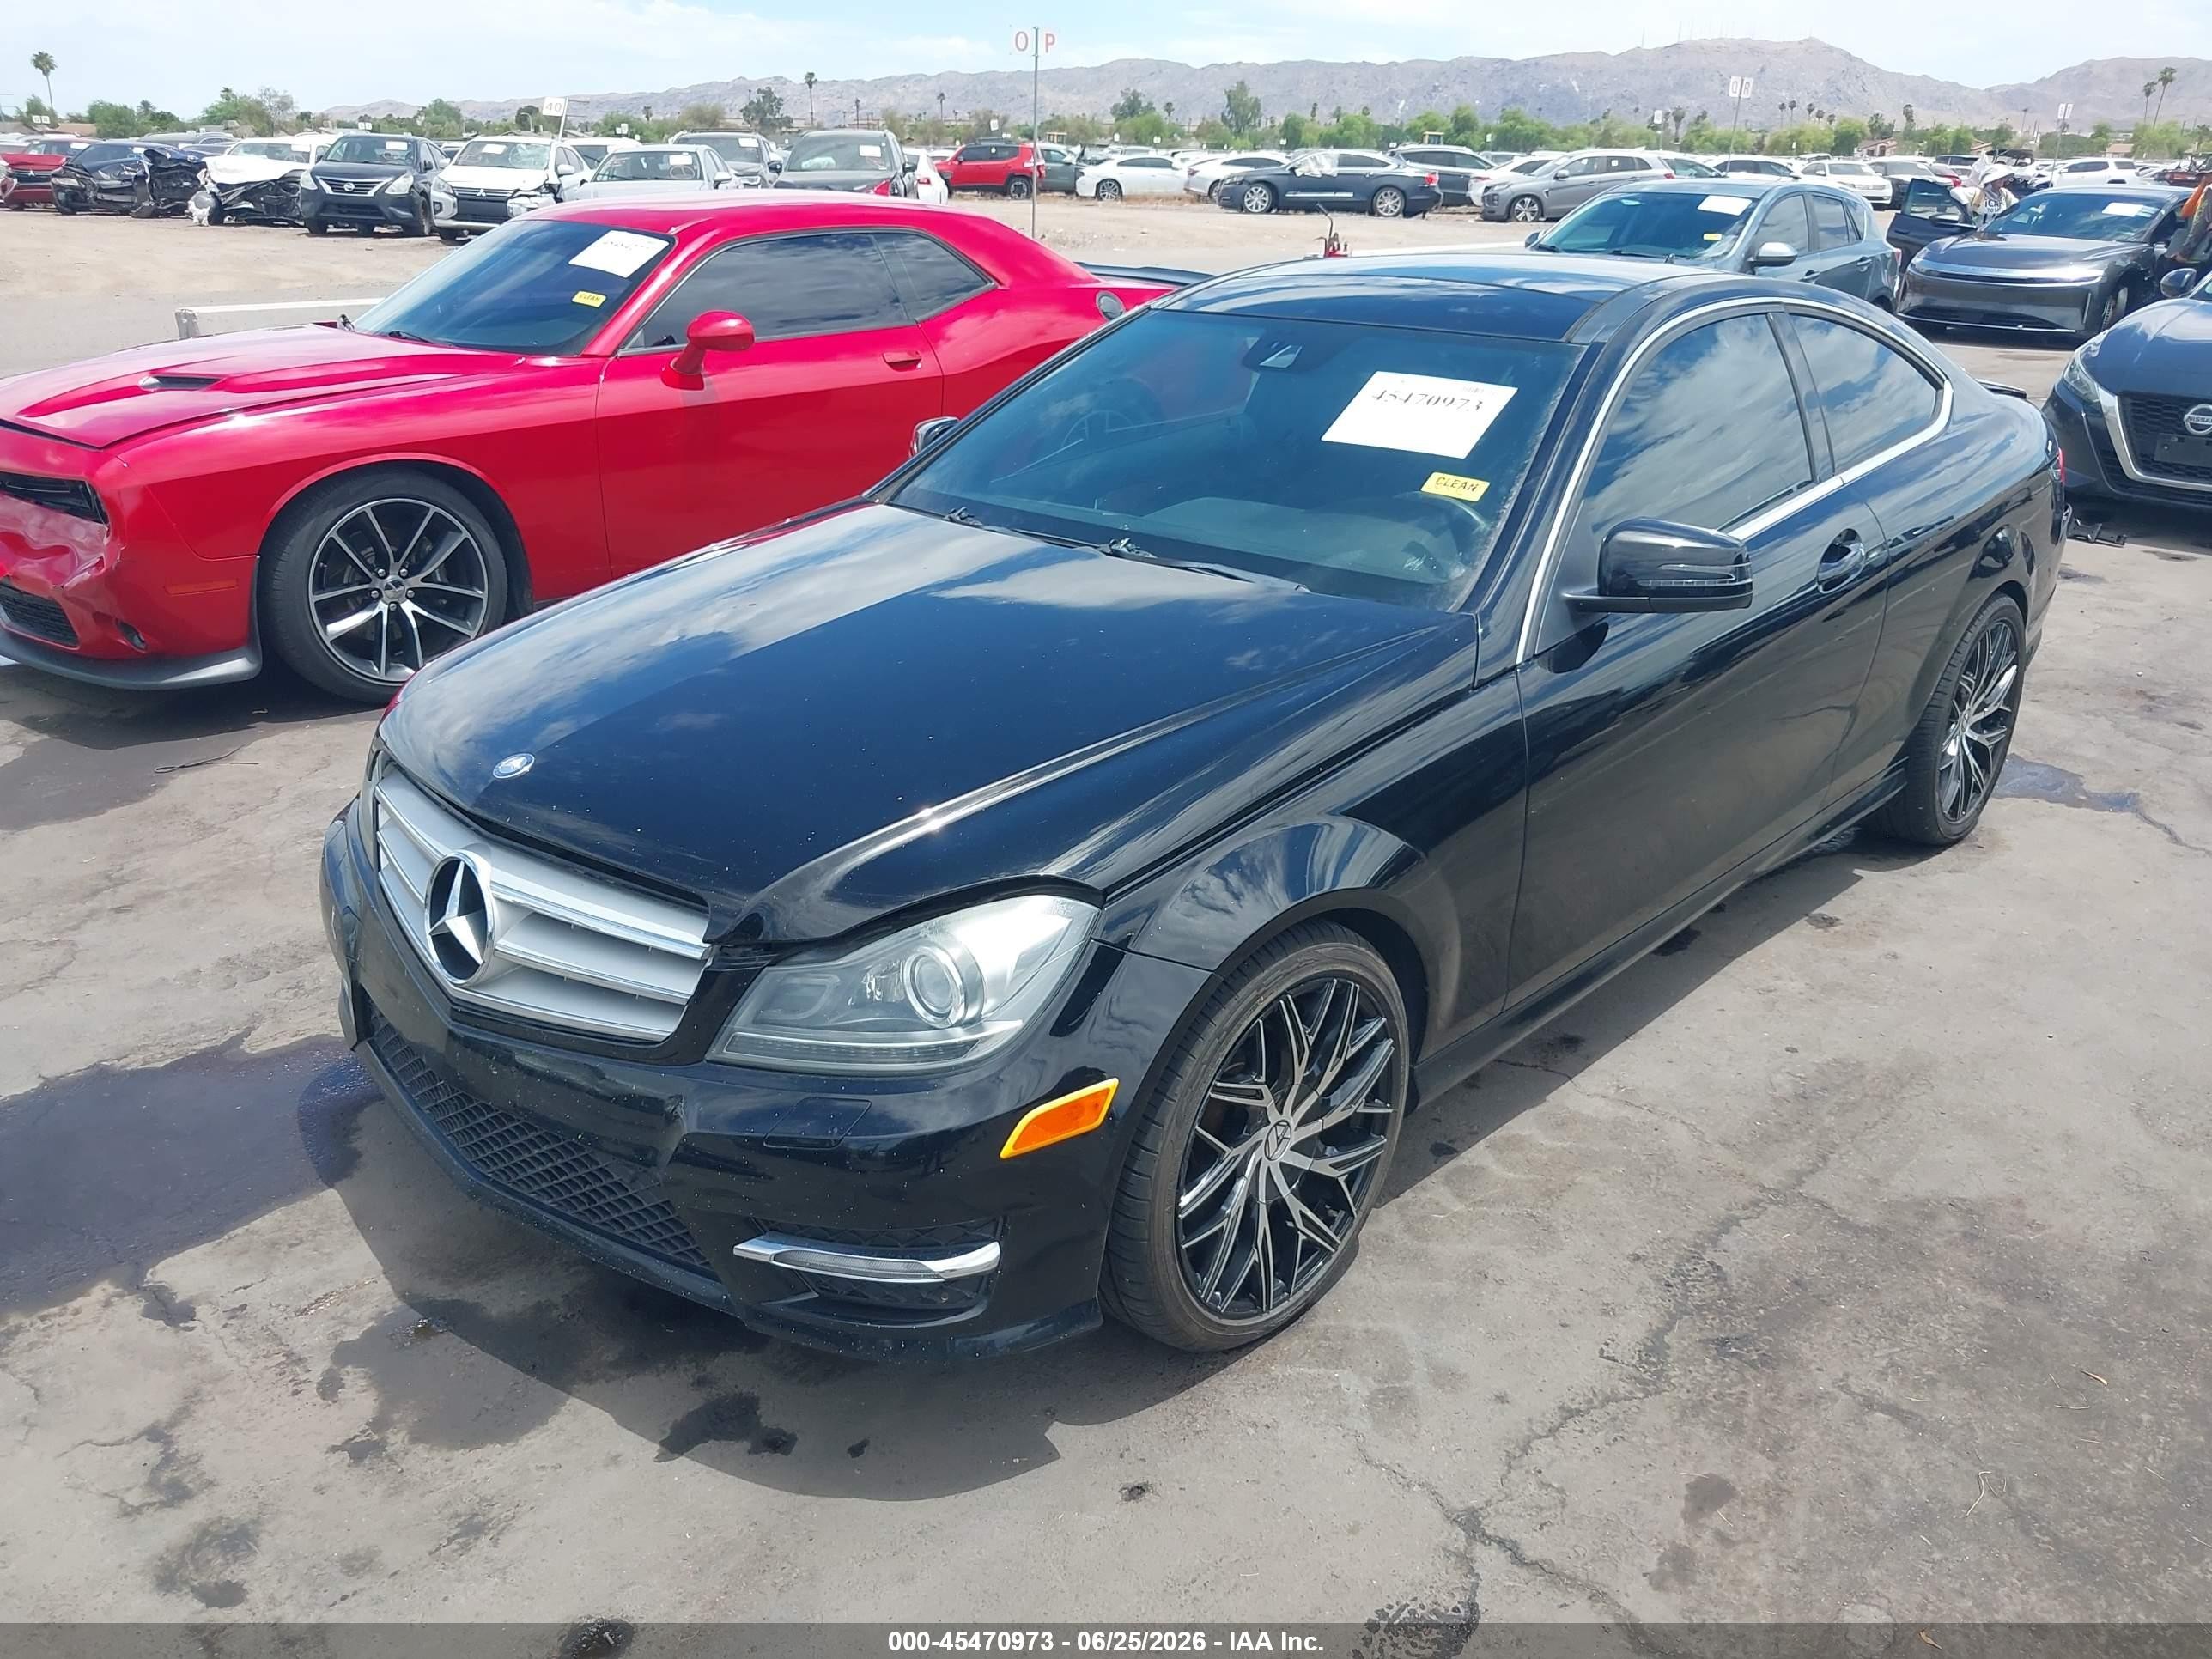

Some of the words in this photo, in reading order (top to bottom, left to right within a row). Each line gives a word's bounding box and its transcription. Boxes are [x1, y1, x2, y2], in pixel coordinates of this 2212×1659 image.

[1045, 33, 1056, 53] P
[1371, 389, 1484, 411] 45470973
[1435, 476, 1479, 493] CLEAN
